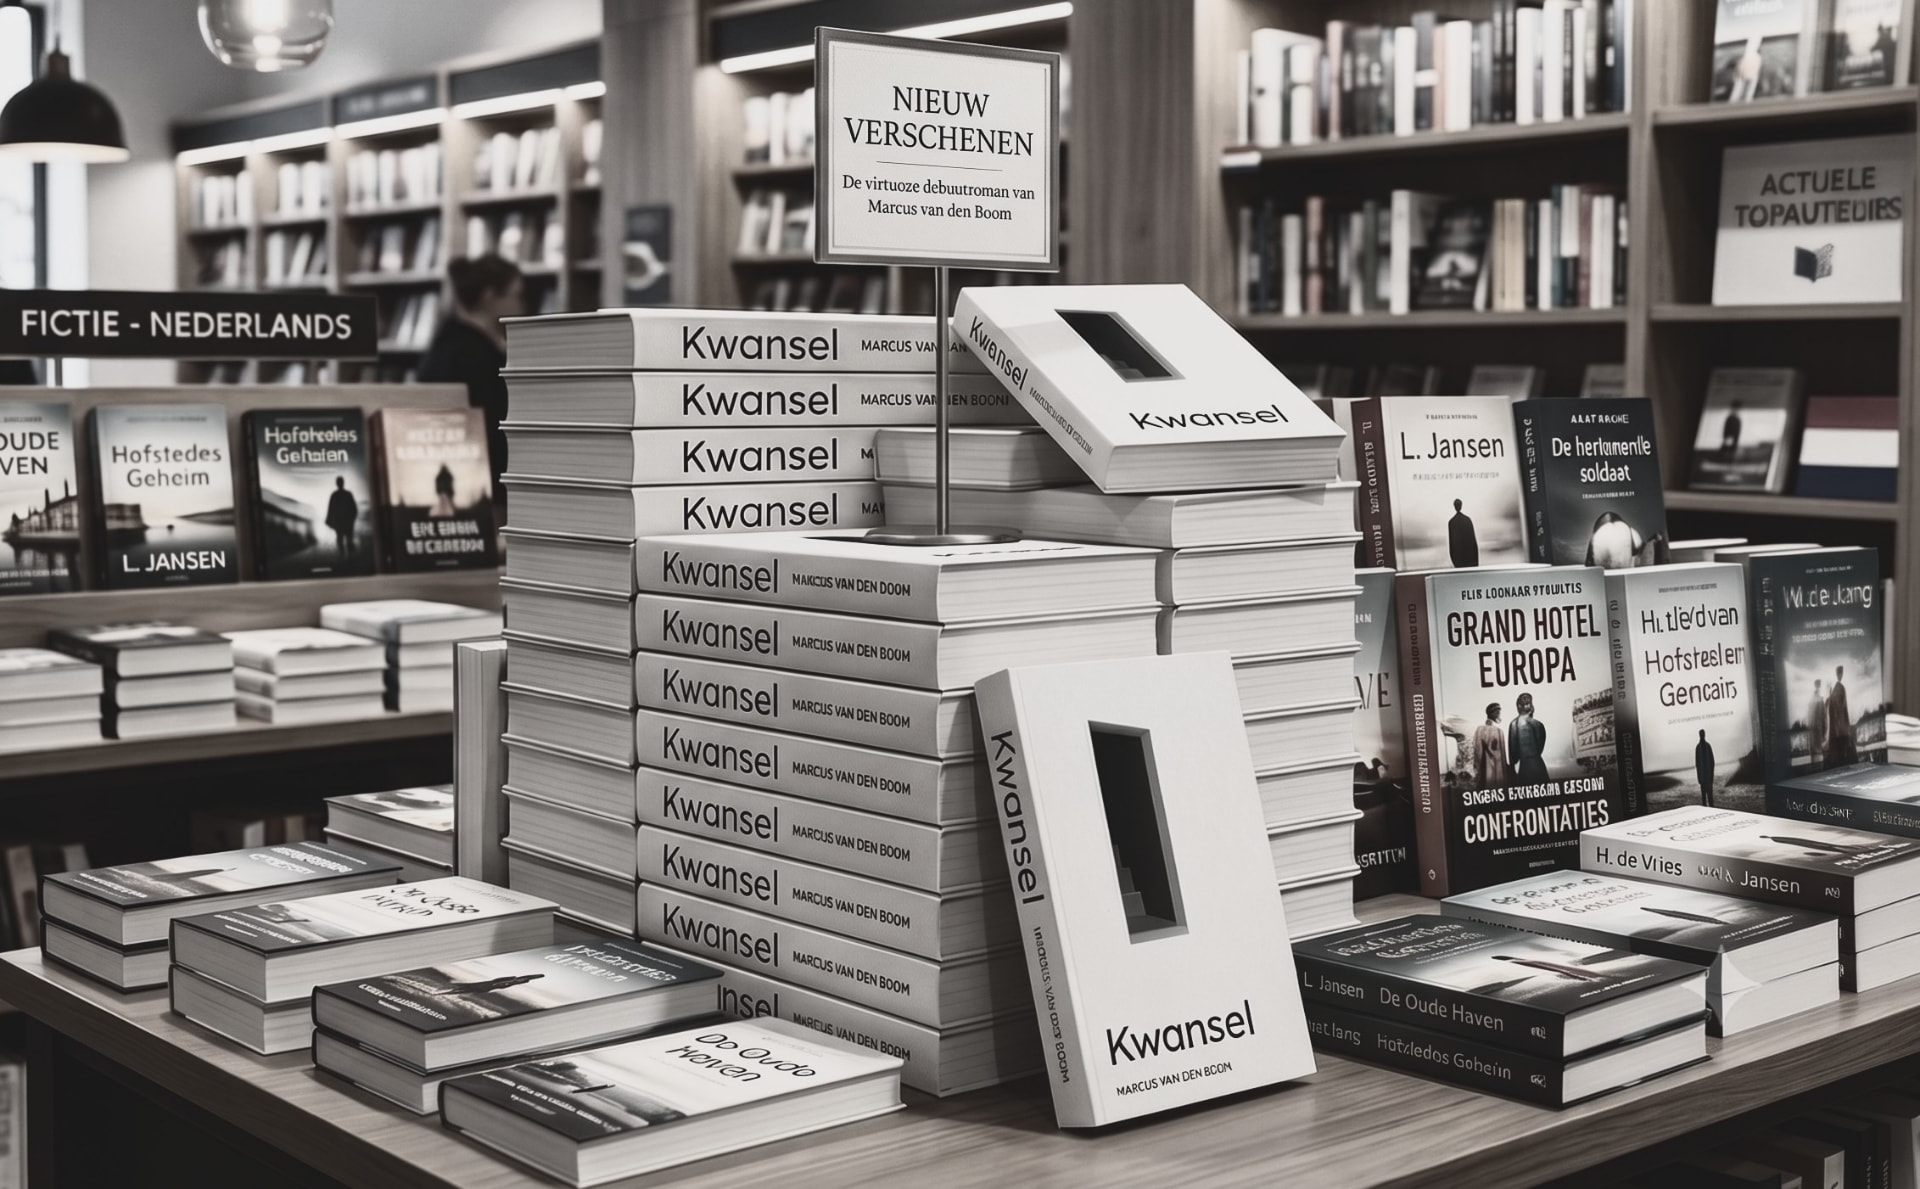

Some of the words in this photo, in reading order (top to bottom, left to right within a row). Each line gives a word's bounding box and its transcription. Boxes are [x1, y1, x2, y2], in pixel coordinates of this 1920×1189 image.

[893, 85, 990, 118] NIEUW
[844, 117, 1034, 157] VERSCHENEN
[842, 174, 862, 190] De
[865, 176, 920, 193] virtuoze
[923, 178, 1010, 198] debuutroman
[1012, 187, 1035, 200] van
[1760, 166, 1876, 196] ACTUELE
[868, 199, 917, 216] Marcus
[920, 204, 944, 217] van
[947, 203, 971, 218] den
[974, 205, 1012, 220] Boom
[21, 309, 119, 338] FICTIE
[150, 311, 352, 339] NEDERLANDS
[683, 325, 839, 361] Kwansel
[861, 340, 912, 353] MARCUS
[969, 315, 1029, 391] Kwansel
[683, 383, 839, 416] Kwansel
[861, 394, 912, 406] MARCUS
[1129, 404, 1289, 430] Kwansel
[111, 443, 222, 463] Hofstedes
[683, 437, 839, 473] Kwansel
[1401, 431, 1421, 460] L.
[1427, 432, 1504, 458] Jansen
[1551, 437, 1571, 457] De
[127, 467, 210, 487] Geheim
[1580, 461, 1631, 482] soldaat
[683, 492, 839, 530] Kwansel
[145, 550, 226, 573] JANSEN
[663, 550, 778, 594] Kwansel
[834, 576, 855, 591] VAN
[856, 578, 878, 594] DEN
[663, 608, 778, 656] Kwansel
[792, 635, 834, 651] MARCUS
[834, 639, 855, 655] VAN
[856, 643, 878, 658] DEN
[879, 647, 911, 662] BOOM
[1447, 608, 1526, 647] GRAND
[1533, 604, 1601, 641] HOTEL
[1478, 646, 1576, 688] EUROPA
[663, 668, 778, 717] Kwansel
[792, 699, 834, 716] MARCUS
[834, 704, 855, 720] VAN
[856, 708, 878, 724] DEN
[879, 712, 911, 728] BOOM
[663, 726, 778, 779] Kwansel
[792, 761, 834, 780] MARCUS
[834, 766, 855, 784] VAN
[856, 773, 878, 790] DEN
[663, 785, 778, 842] Kwansel
[792, 824, 834, 844] MARCUS
[834, 830, 855, 850] VAN
[856, 837, 878, 855] DEN
[879, 843, 911, 862] BOOM
[991, 730, 1045, 905] Kwansel
[1464, 798, 1609, 844] CONFRONTATIES
[663, 843, 778, 906] Kwansel
[792, 887, 834, 908] MARCUS
[834, 893, 855, 914] VAN
[856, 902, 878, 921] DEN
[879, 909, 911, 929] BOOM
[1596, 845, 1613, 865] H.
[1617, 851, 1638, 868] de
[1740, 870, 1800, 894] Jansen
[663, 902, 778, 967] Kwansel
[792, 950, 834, 973] MARCUS
[834, 958, 855, 979] VAN
[856, 968, 878, 986] DEN
[879, 975, 911, 996] BOOM
[1319, 974, 1364, 1000] Jansen
[1380, 987, 1401, 1008] De
[1405, 993, 1448, 1018] Oude
[1452, 1003, 1504, 1032] Haven
[836, 1024, 855, 1042] VAN
[856, 1033, 878, 1050] DEN
[1106, 999, 1256, 1066] Kwansel
[1116, 1078, 1159, 1096] MARCUS
[1159, 1074, 1180, 1087] VAN
[1182, 1069, 1203, 1082] DEN
